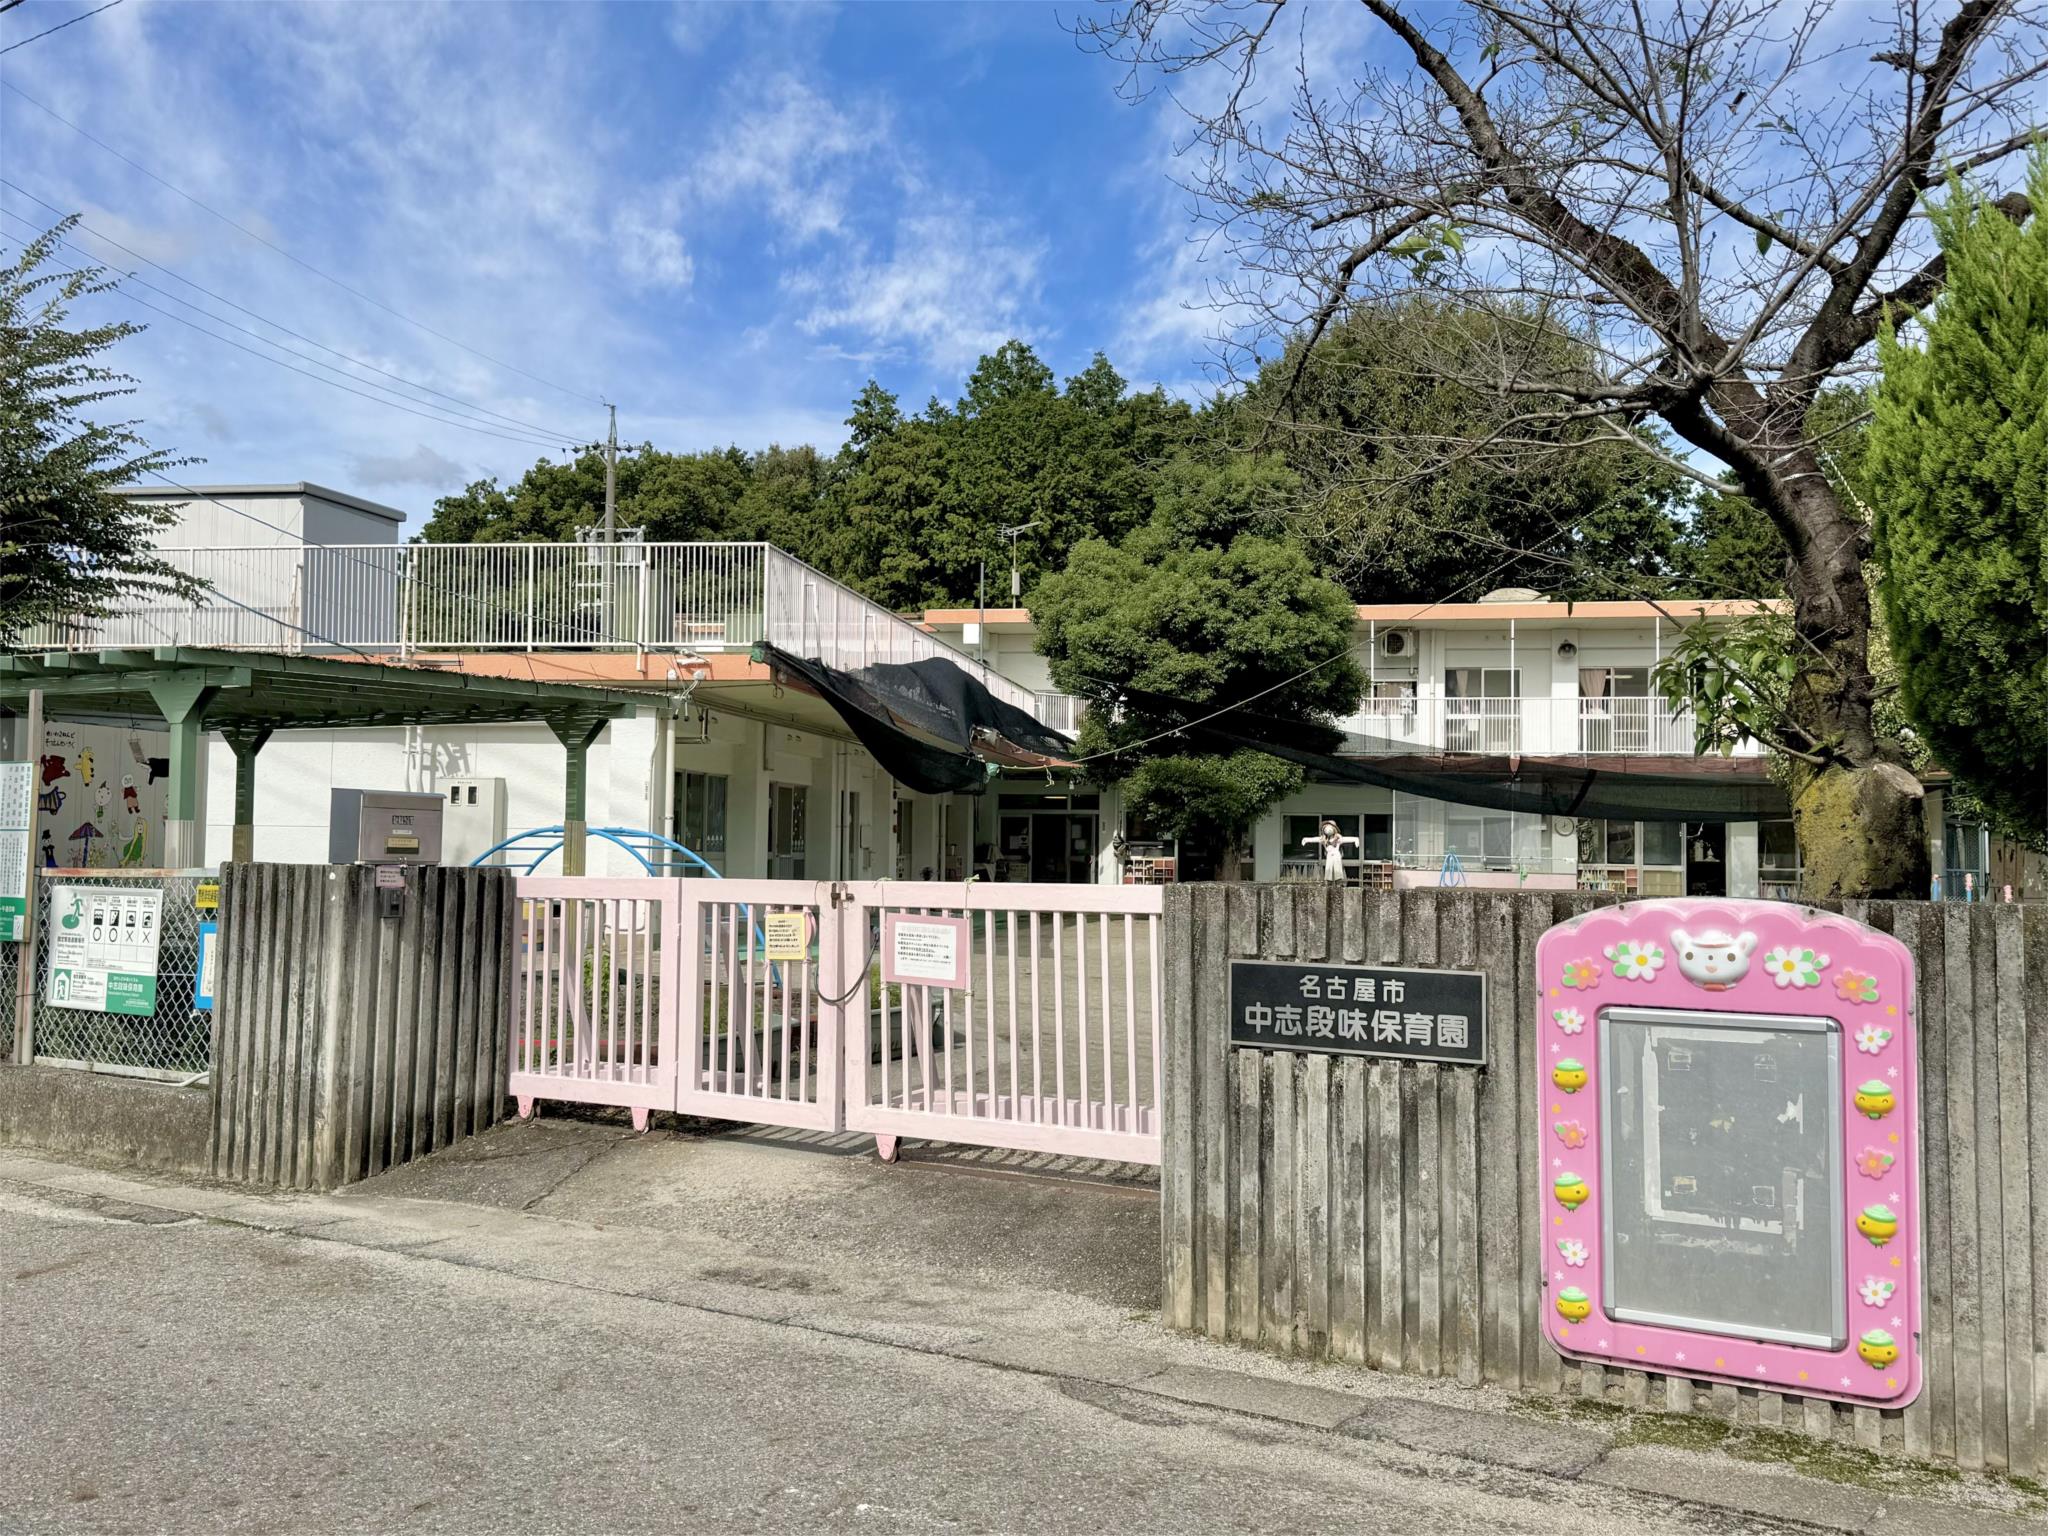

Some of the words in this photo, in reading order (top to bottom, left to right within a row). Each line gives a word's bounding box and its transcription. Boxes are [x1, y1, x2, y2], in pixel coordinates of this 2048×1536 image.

[1299, 974, 1406, 1004] 名古屋市
[1244, 1001, 1469, 1048] 中志段味保育園
